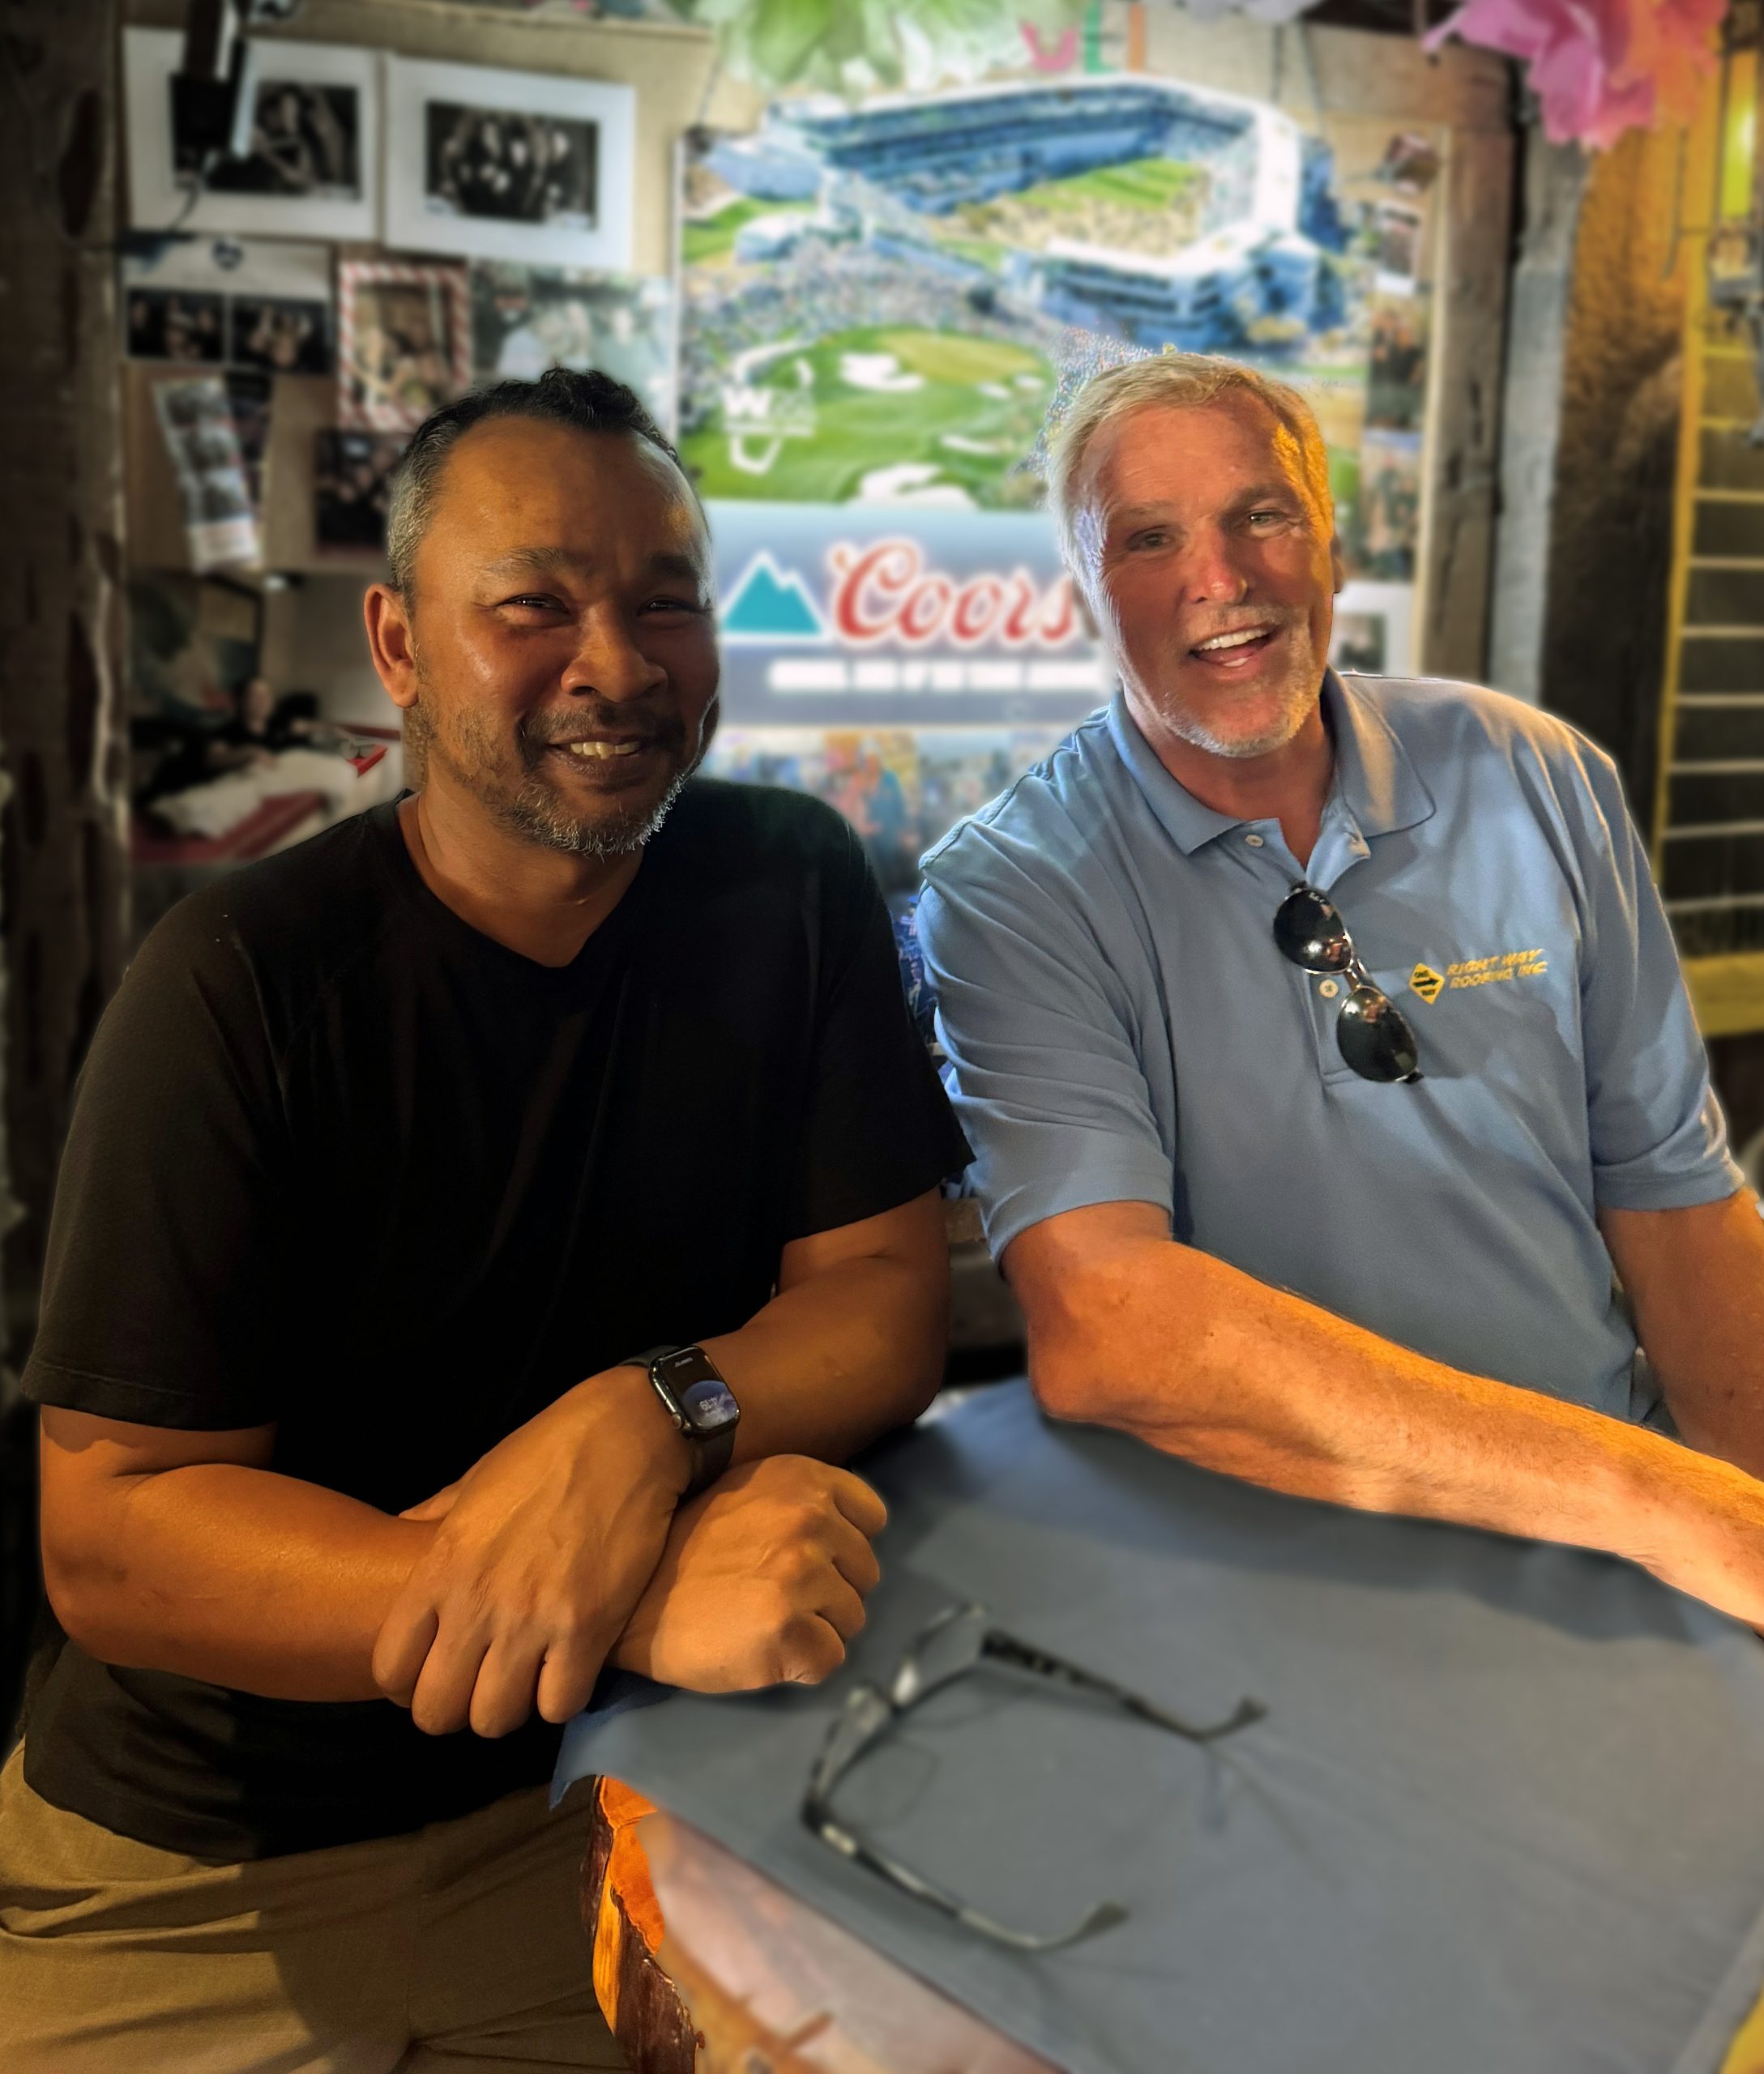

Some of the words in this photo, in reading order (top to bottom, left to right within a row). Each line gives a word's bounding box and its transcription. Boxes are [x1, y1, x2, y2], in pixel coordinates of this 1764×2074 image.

[833, 541, 1075, 641] Coors
[1446, 955, 1499, 976] RIGHT
[1450, 967, 1513, 988] ROOFING
